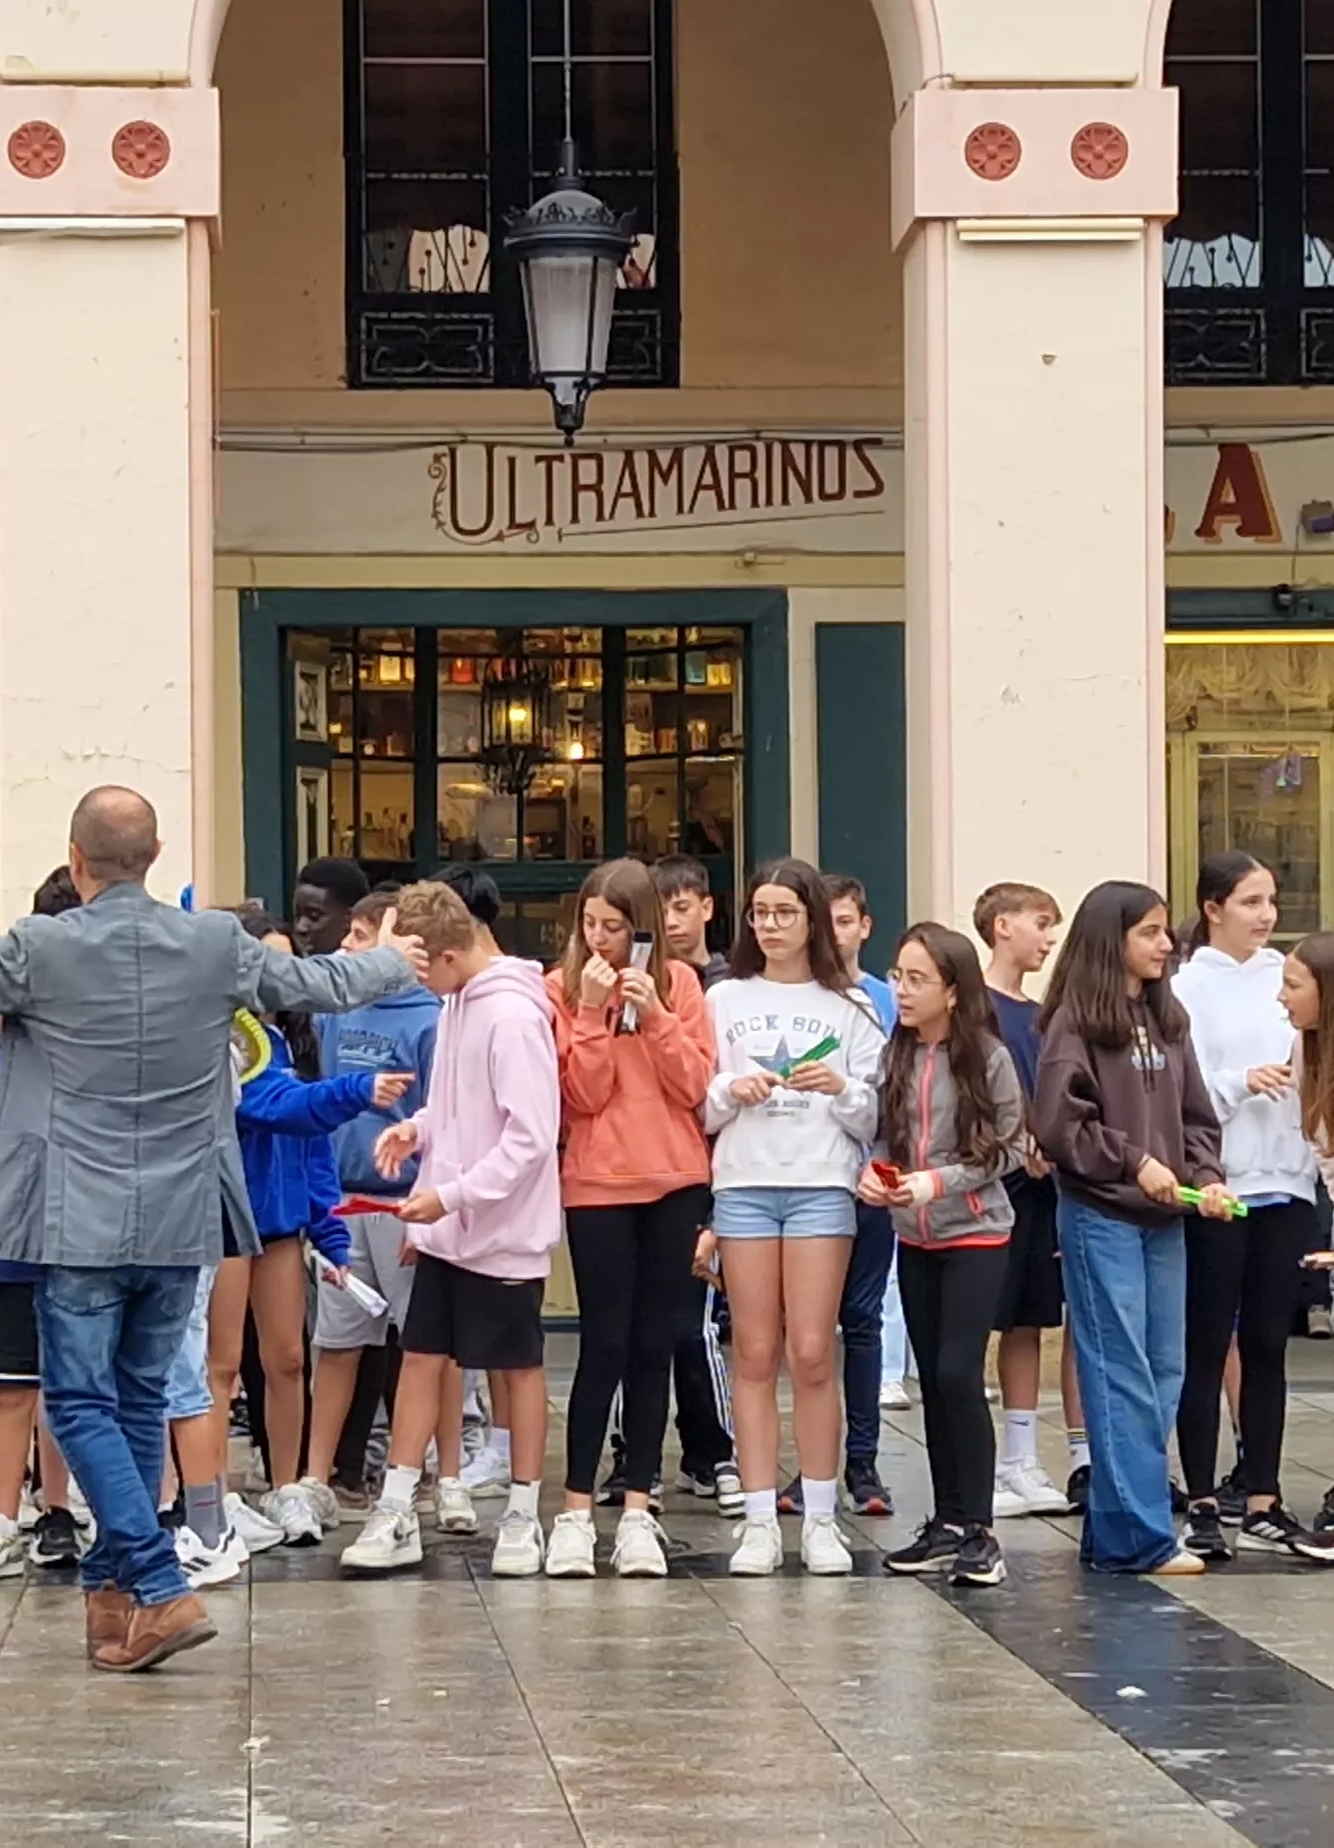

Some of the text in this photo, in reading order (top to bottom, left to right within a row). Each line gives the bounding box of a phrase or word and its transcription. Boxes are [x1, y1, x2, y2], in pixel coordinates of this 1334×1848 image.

[448, 437, 885, 537] ULTRAMARINOS
[1164, 443, 1282, 543] A
[726, 1014, 843, 1046] ROCK SOU
